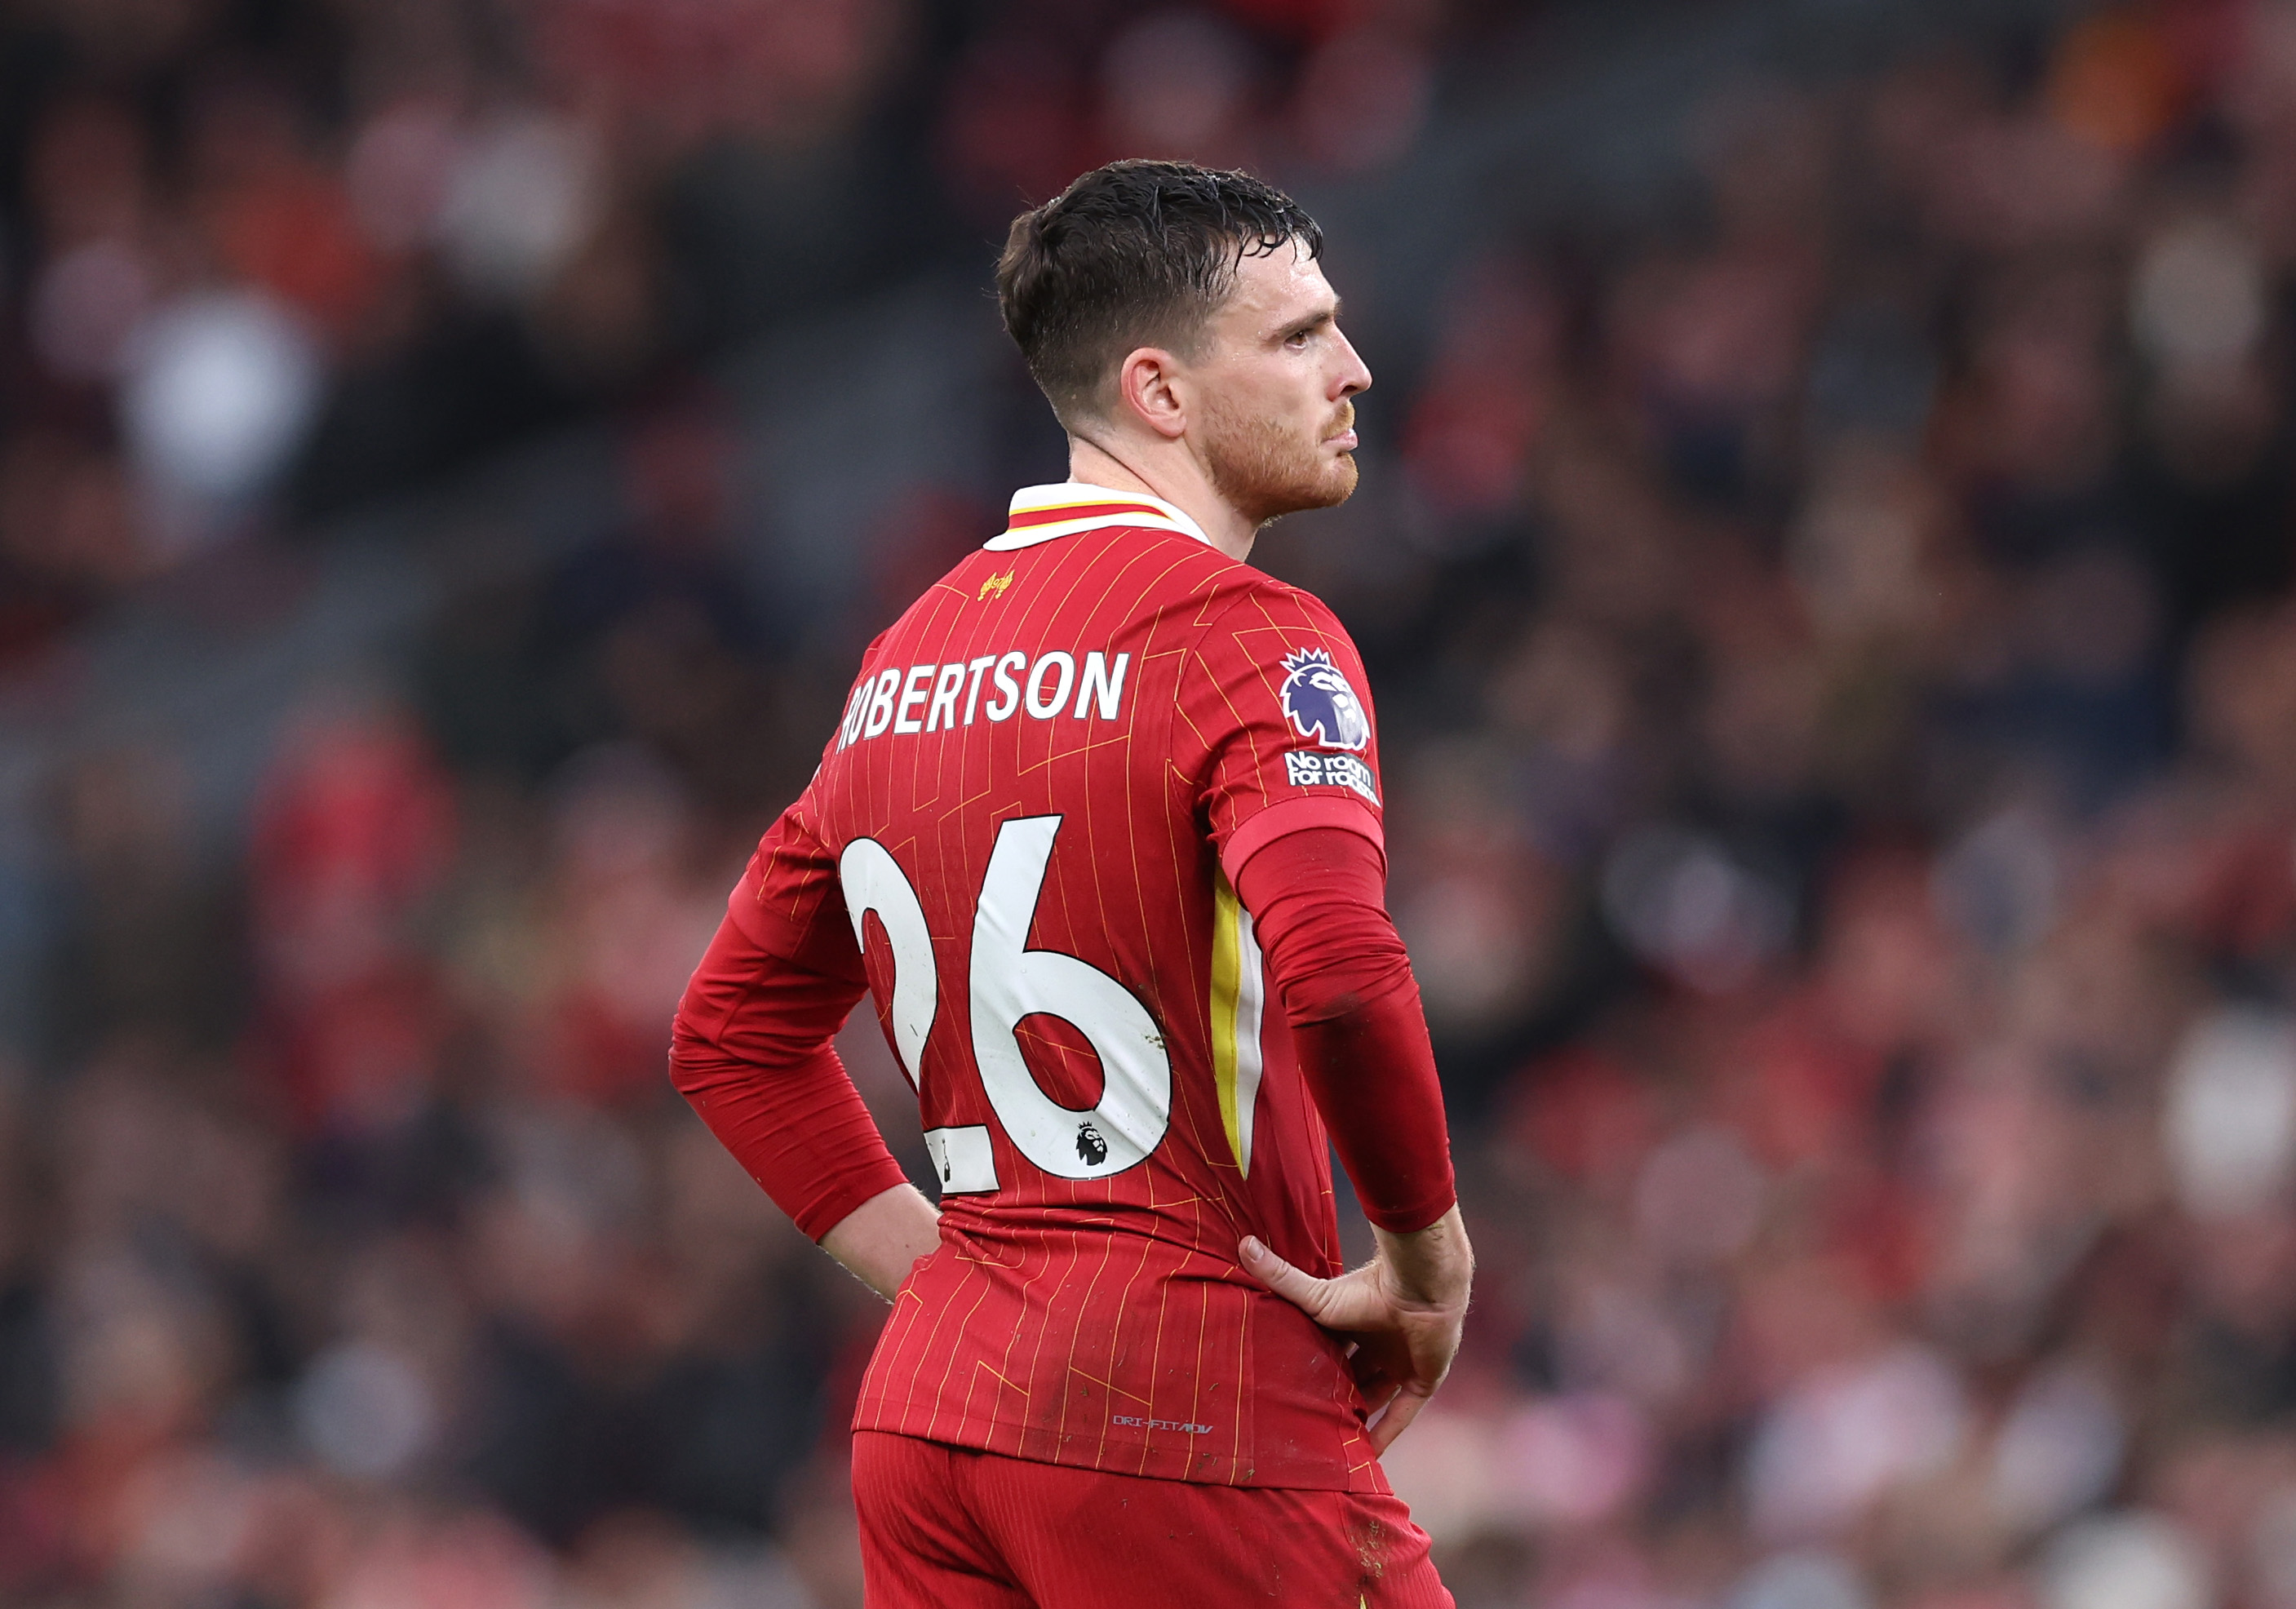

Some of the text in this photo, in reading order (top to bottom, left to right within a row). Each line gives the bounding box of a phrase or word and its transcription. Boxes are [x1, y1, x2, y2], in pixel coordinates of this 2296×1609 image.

[836, 651, 1130, 755] ROBERTSON
[1284, 751, 1372, 787] No room
[1288, 767, 1323, 786] for
[840, 814, 1172, 1194] 26
